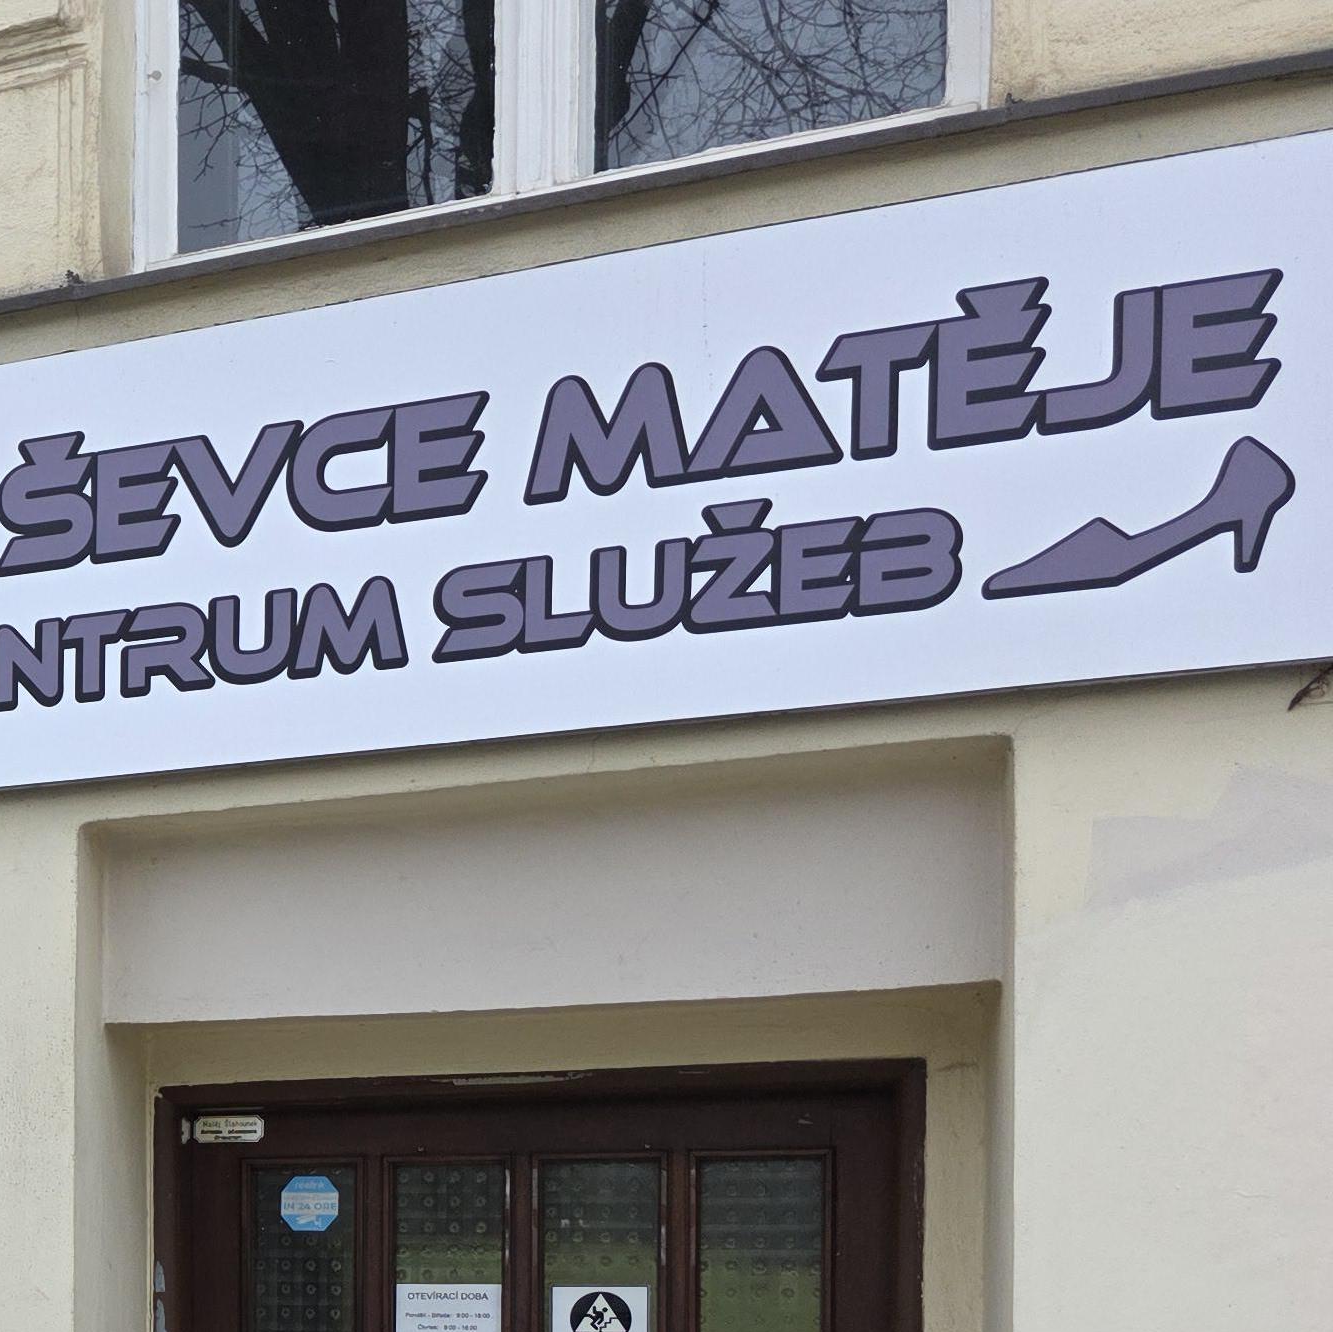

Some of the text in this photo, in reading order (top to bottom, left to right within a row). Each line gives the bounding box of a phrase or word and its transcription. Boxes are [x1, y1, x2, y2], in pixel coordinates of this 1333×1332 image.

[524, 266, 1285, 510] MATĚJE
[430, 497, 964, 664] SLUŽEB
[407, 1291, 489, 1301] OTEVÍRACÍ DOBA
